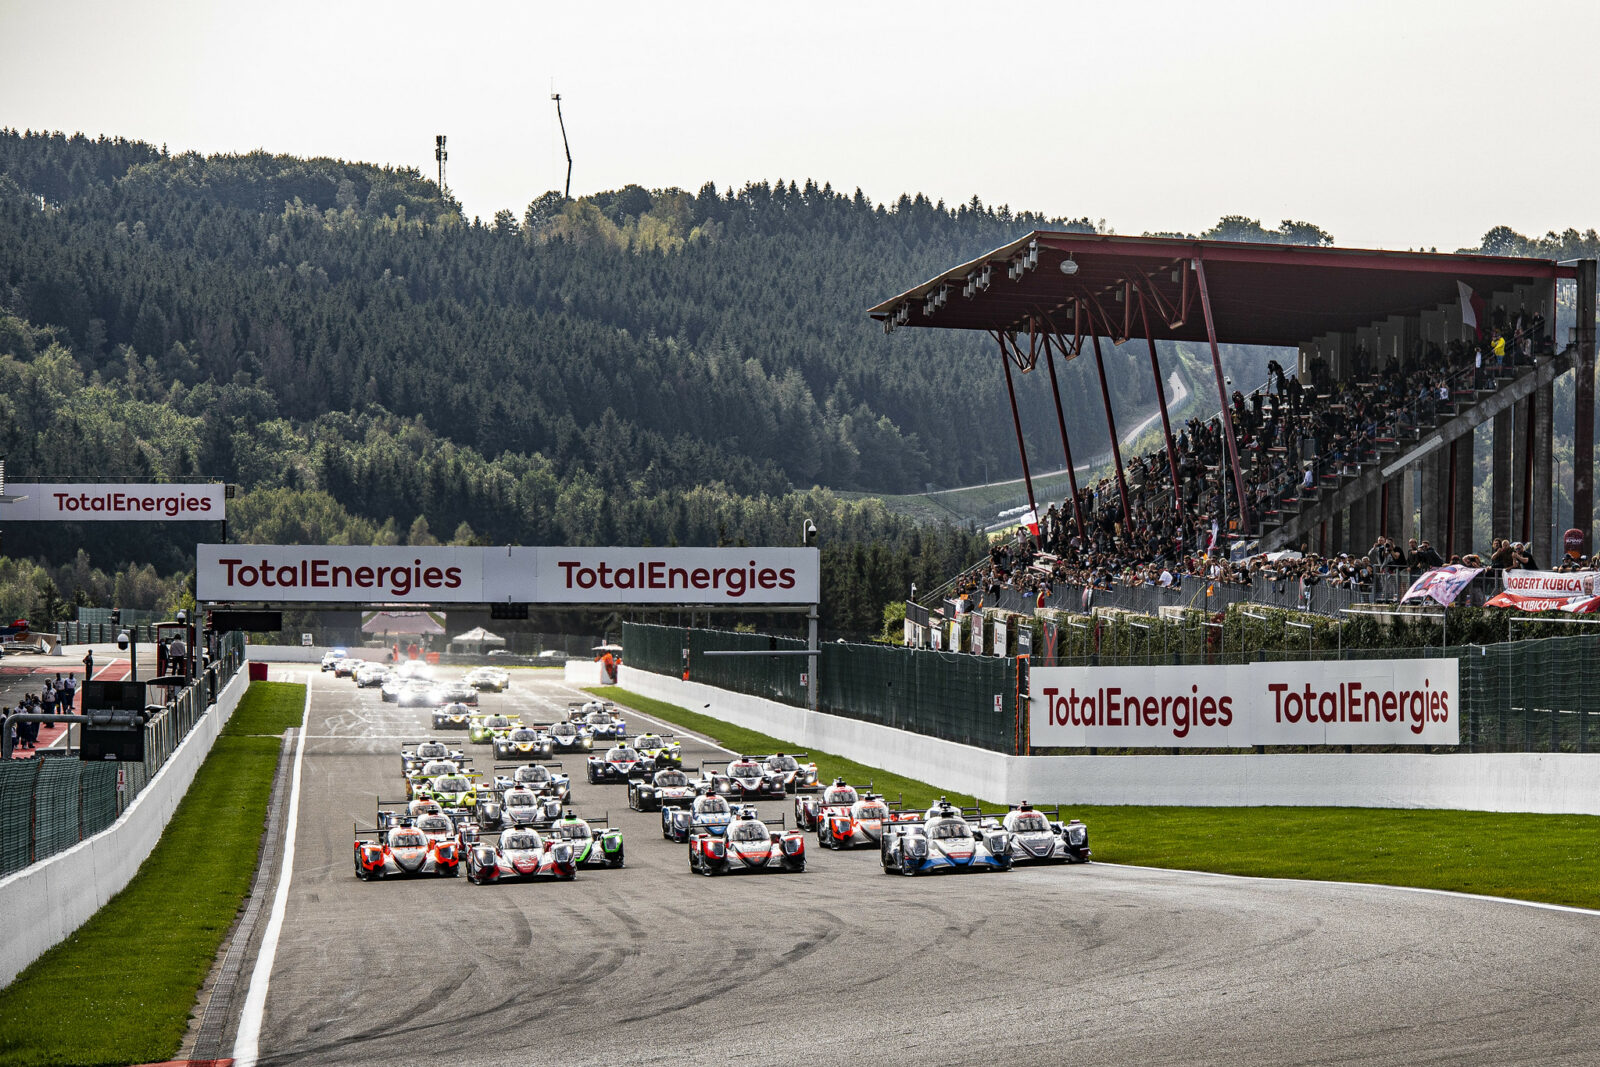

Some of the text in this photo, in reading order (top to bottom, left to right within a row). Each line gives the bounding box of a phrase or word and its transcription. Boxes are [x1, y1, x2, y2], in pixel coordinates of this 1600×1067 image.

[53, 492, 212, 517] TotalEnergies
[218, 558, 462, 597] TotalEnergies
[557, 559, 796, 598] TotalEnergies
[1507, 577, 1582, 592] ROBERT KUBICA
[1043, 684, 1233, 739] TotalEnergies
[1267, 678, 1450, 735] TotalEnergies
